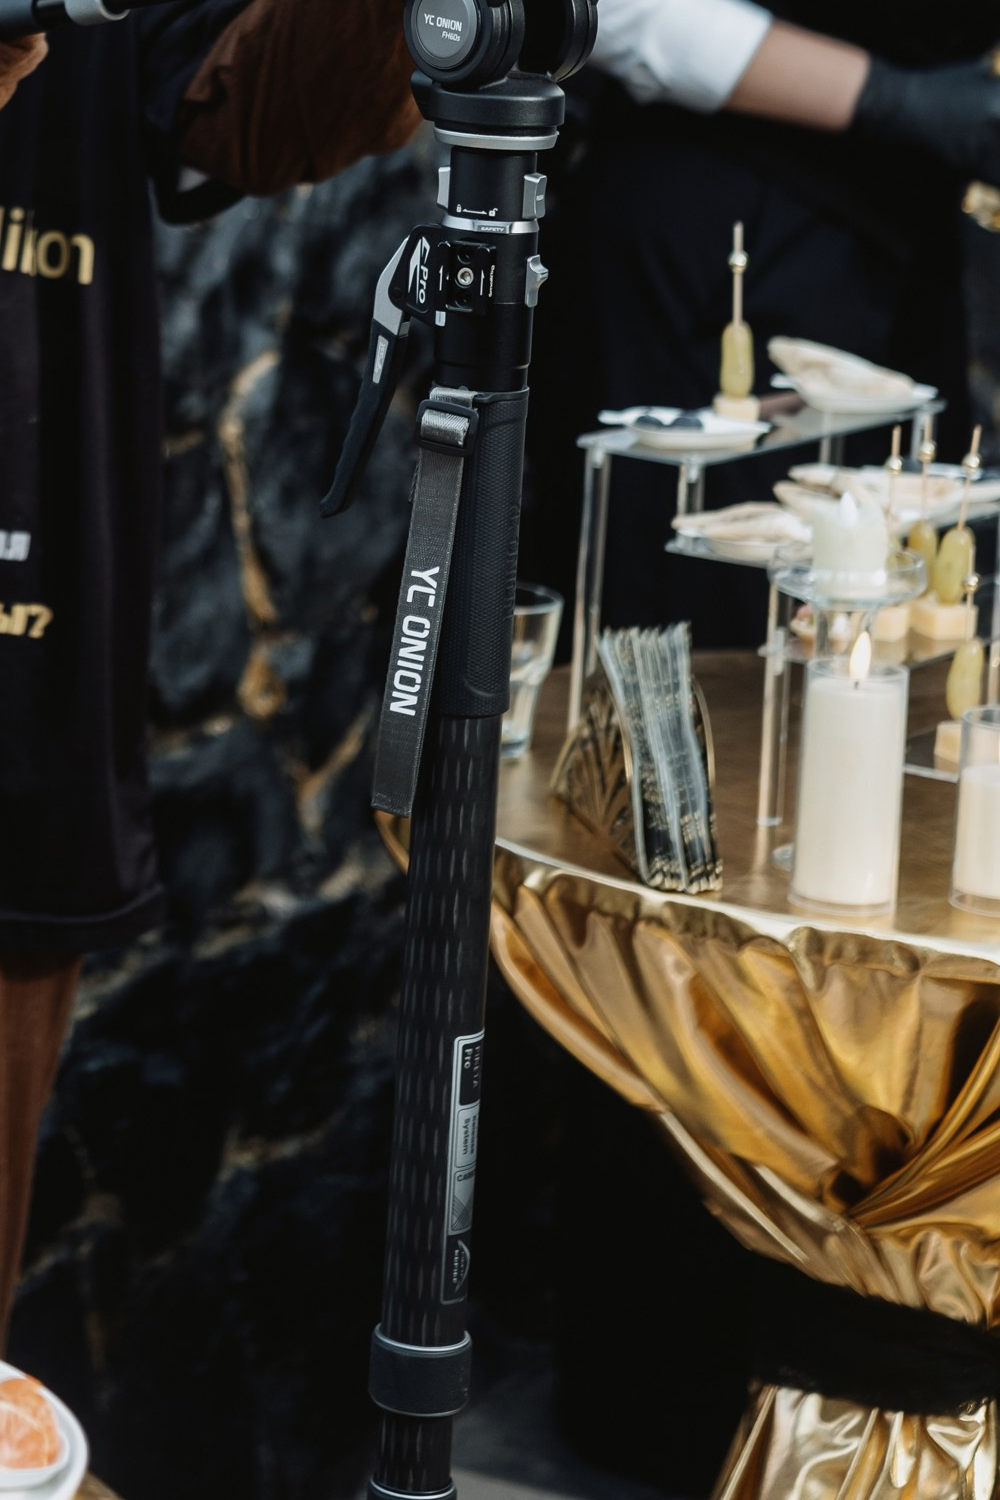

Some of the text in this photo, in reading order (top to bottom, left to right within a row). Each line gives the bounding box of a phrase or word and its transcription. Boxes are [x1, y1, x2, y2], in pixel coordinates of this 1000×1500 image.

[424, 13, 462, 32] YC ONION
[389, 566, 440, 716] YC ONION
[464, 1048, 473, 1069] Pro
